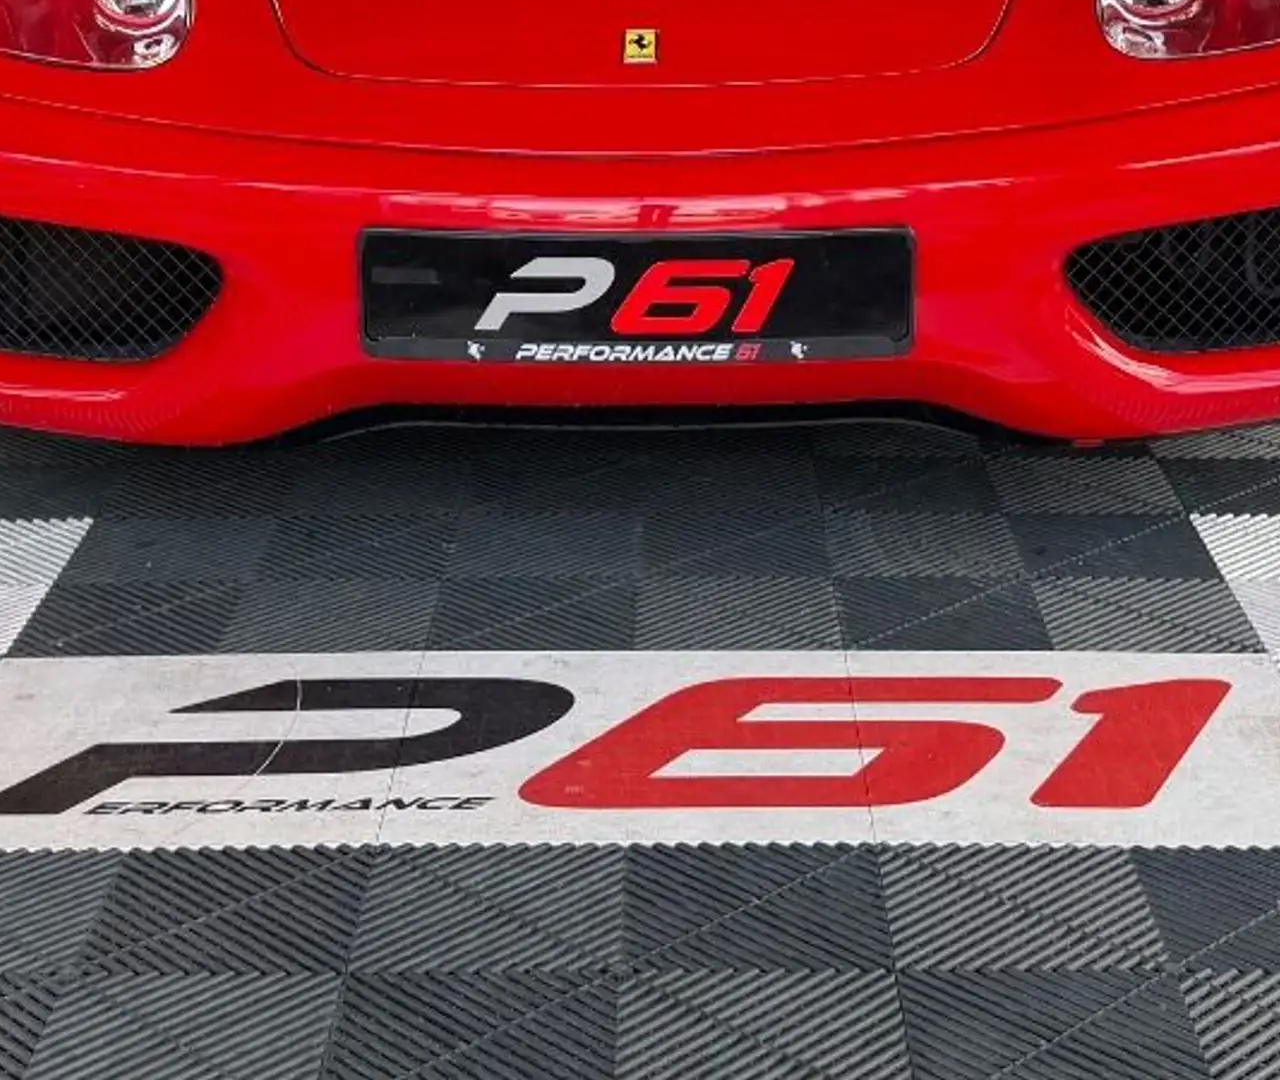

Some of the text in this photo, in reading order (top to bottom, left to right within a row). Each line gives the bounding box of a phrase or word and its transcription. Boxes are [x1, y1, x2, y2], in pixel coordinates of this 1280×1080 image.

[474, 256, 794, 335] P61
[515, 342, 762, 362] PERFORMANCE 61
